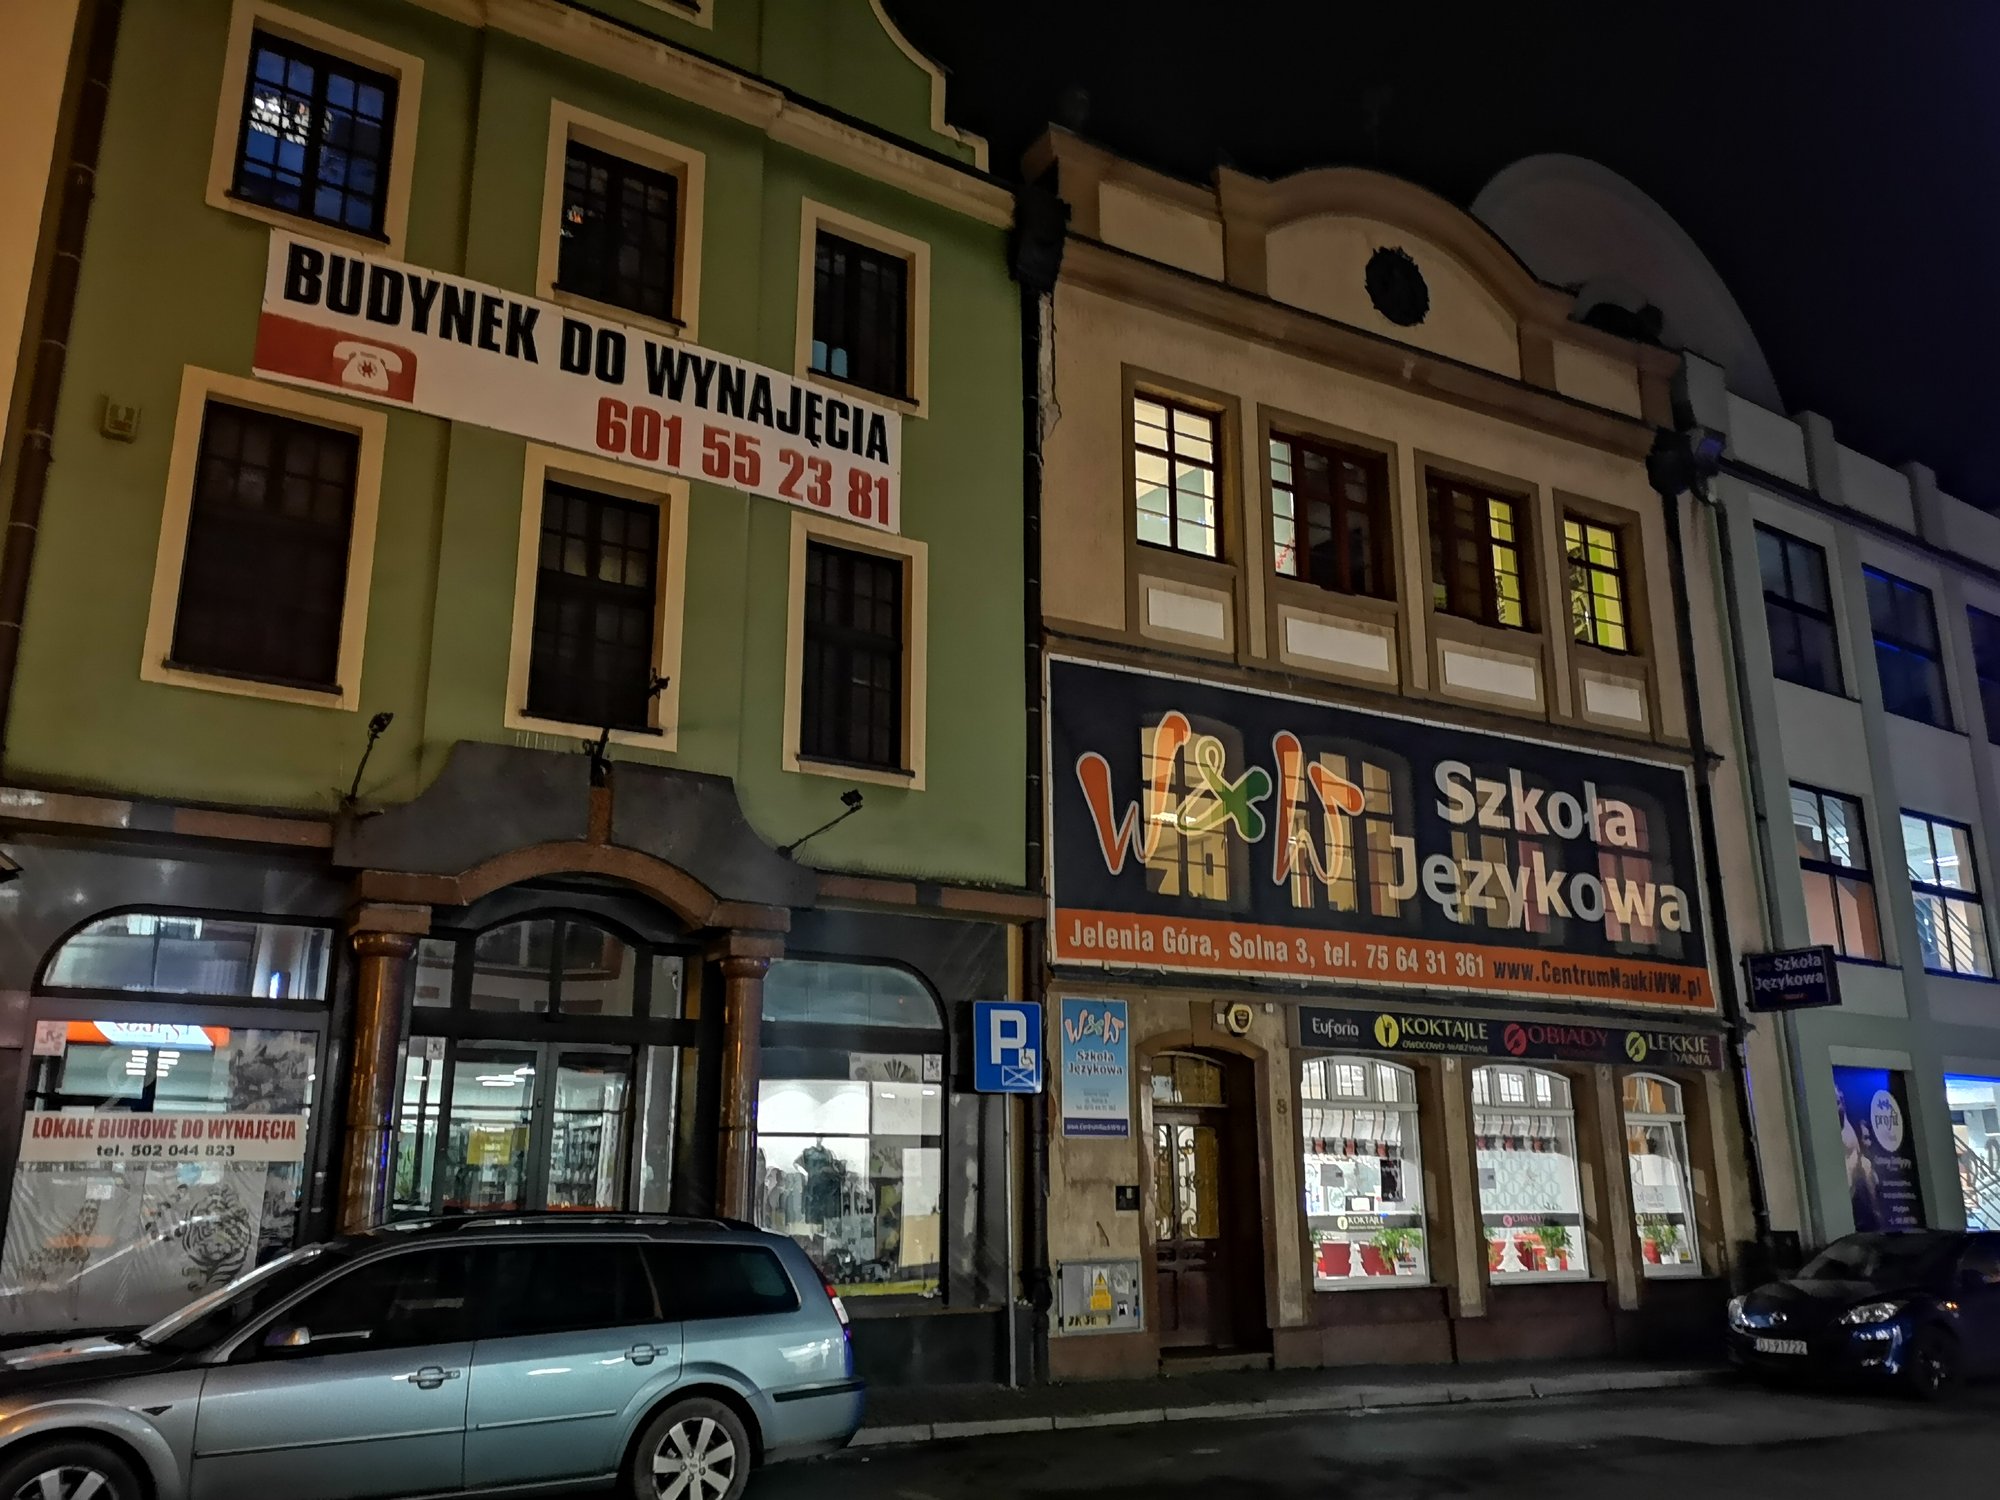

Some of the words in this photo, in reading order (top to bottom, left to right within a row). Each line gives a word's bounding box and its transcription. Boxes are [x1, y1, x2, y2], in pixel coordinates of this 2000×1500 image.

[284, 242, 540, 364] BUDYNEK
[560, 317, 627, 385] DO
[645, 340, 889, 465] WYNAJĘCIA
[596, 397, 682, 469] 601
[702, 424, 761, 487] 55
[778, 449, 832, 508] 23
[848, 467, 889, 526] 81
[1434, 760, 1638, 848] Szkoła
[1388, 835, 1691, 933] Językowa
[1069, 919, 1154, 952] Jelenia
[1162, 926, 1220, 962] Góra,
[1229, 931, 1288, 962] Solna
[1296, 938, 1316, 968] 3,
[1324, 941, 1357, 968] tel.
[1366, 944, 1388, 971] 75
[1396, 946, 1419, 973] 64
[1425, 949, 1447, 976] 31
[1456, 952, 1484, 978] 361
[1493, 959, 1702, 1001] www.CentrumNaukiWW.pl
[1774, 953, 1822, 972] Szkoła
[991, 1009, 1027, 1065] P
[1312, 1016, 1360, 1038] Euforia
[1401, 1017, 1489, 1041] KOKTAJLE
[1527, 1024, 1609, 1048] OBIADY
[1649, 1033, 1709, 1053] LEKKIE
[32, 1117, 95, 1139] LOKALE
[98, 1118, 178, 1140] BIUROWE
[181, 1118, 202, 1140] DO
[207, 1119, 297, 1143] WYNAJĘCIA
[96, 1145, 124, 1157] tel.
[131, 1145, 163, 1157] 502
[168, 1145, 199, 1157] 044
[205, 1145, 236, 1157] 823
